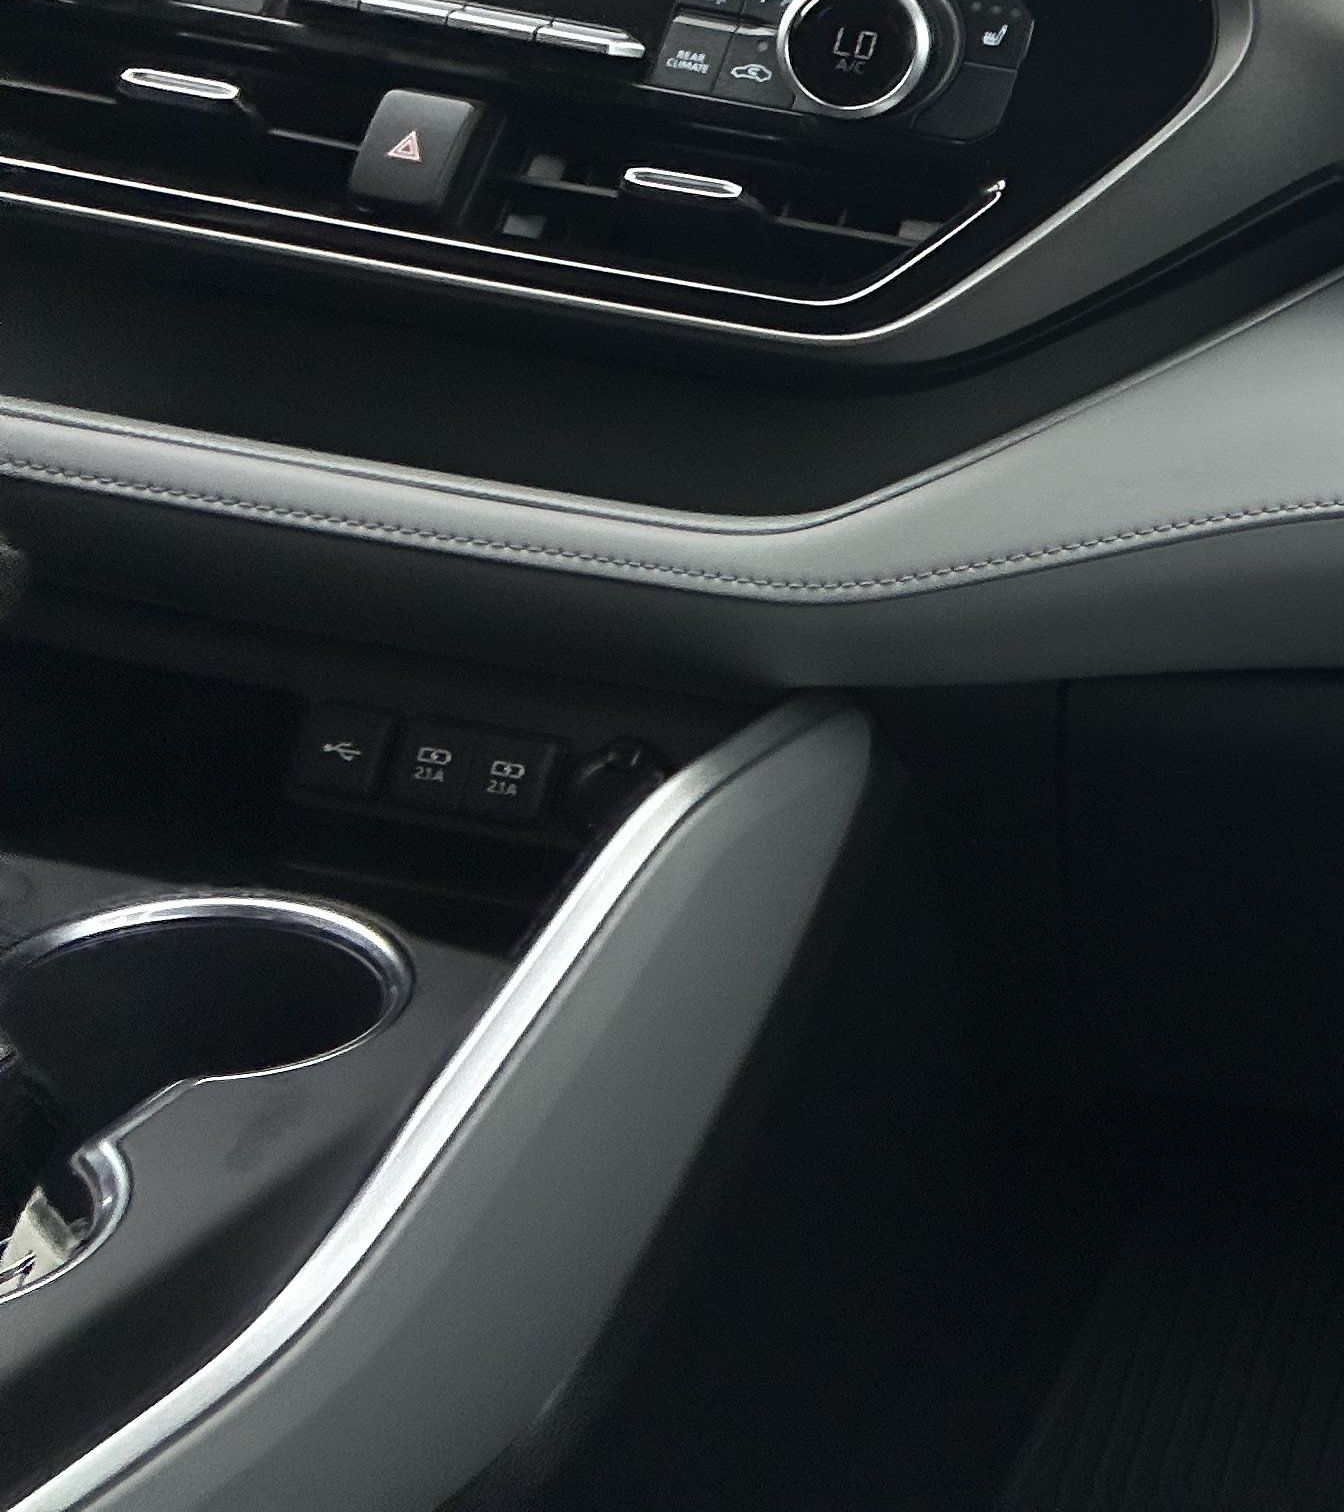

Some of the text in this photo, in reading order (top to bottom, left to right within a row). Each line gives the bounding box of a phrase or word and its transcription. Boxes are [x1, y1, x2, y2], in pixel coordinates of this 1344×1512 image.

[676, 49, 707, 63] REAR
[666, 56, 710, 74] CLIMATE
[835, 58, 867, 74] A/C
